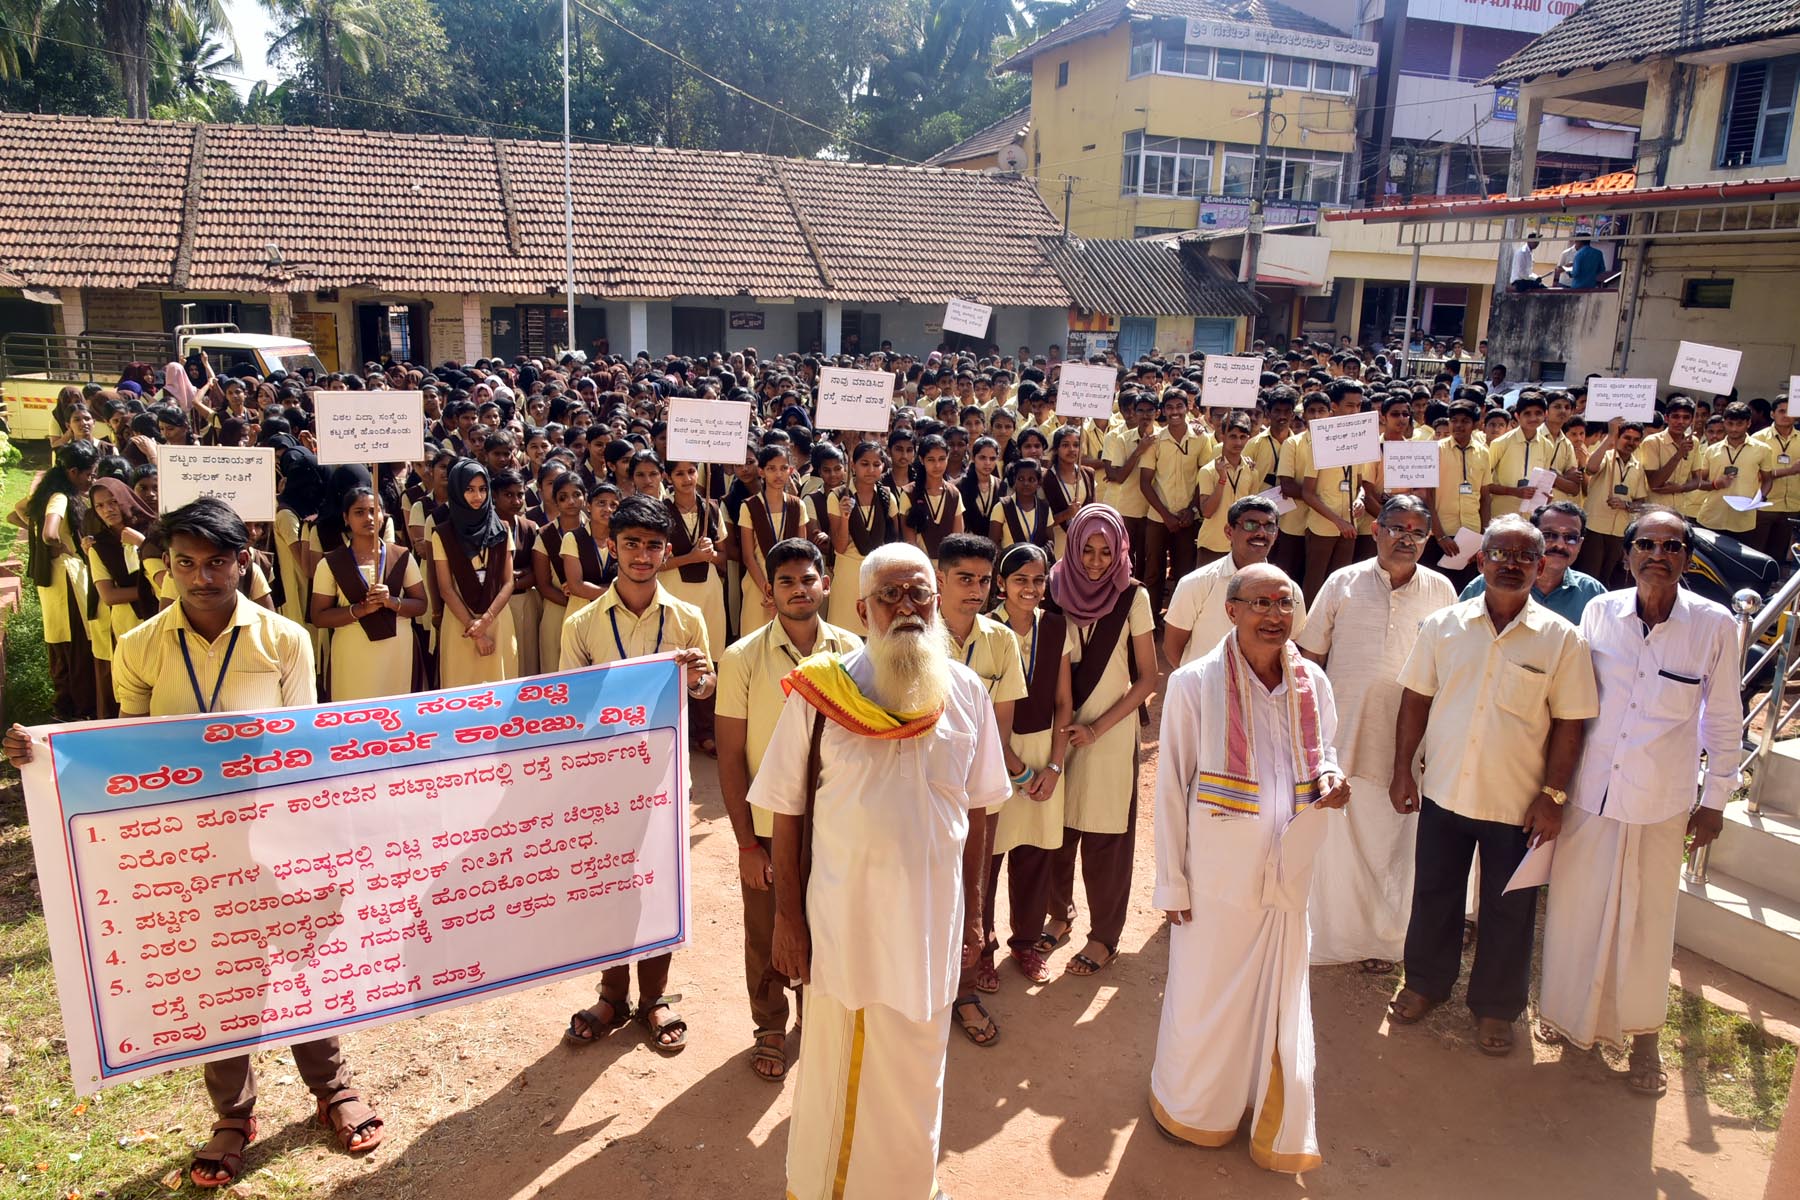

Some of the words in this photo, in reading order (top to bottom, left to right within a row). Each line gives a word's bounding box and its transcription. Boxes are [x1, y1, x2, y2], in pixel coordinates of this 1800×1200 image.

[823, 392, 837, 405] ರಸ್ತೆ
[841, 394, 862, 403] ನಮಗೆ
[865, 396, 886, 408] ಮಾತ್ರ
[831, 377, 848, 387] ನಾವು
[852, 378, 884, 387] ಮಾಡಿಸಿದ
[169, 455, 198, 467] ಪಟ್ಟಣ
[181, 473, 219, 482] ತುಘಲಕ್
[225, 473, 252, 482] ನೀತಿಗೆ
[354, 442, 368, 452] ರಸ್ತೆ
[372, 441, 389, 449] ಬೇಡ
[204, 718, 295, 743] ವಿಠಲ
[315, 707, 402, 731] ವಿದ್ಯಾ
[418, 691, 502, 714] ಸಂಘ,
[518, 683, 569, 704] ವಿಟ್ಲ
[106, 766, 203, 795] ವಿಠಲ
[222, 749, 313, 778] ಪದವಿ
[331, 731, 438, 762] ಪೂರ್ವ
[455, 714, 584, 744] ಕಾಲೇಜು,
[600, 705, 647, 726] ವಿಟ್ಲ
[87, 826, 106, 844] 1.
[119, 815, 183, 840] ಪದವಿ
[197, 801, 274, 828] ಪೂರ್ವ
[287, 784, 376, 813] ಕಾಲೇಜಿನ
[523, 756, 552, 781] ರಸ್ತೆ
[561, 740, 652, 771] ನಿರ್ಮಾಣಕ್ಕೆ
[95, 889, 118, 905] 2.
[132, 864, 260, 902] ವಿದ್ಯಾರ್ಥಿಗಳ
[273, 845, 374, 880] ಭವಿಷ್ಯದಲ್ಲಿ
[385, 839, 422, 861] ವಿಟ್ಲ
[563, 800, 619, 824] ಚೆಲ್ಲಾಟ
[630, 790, 672, 811] ಬೇಡ.
[118, 842, 217, 871] ವಿರೋಧ.
[100, 919, 122, 936] 3.
[136, 908, 200, 933] ಪಟ್ಟಣ
[367, 860, 449, 891] ತುಘಲಕ್
[461, 847, 513, 873] ನೀತಿಗೆ
[523, 831, 598, 859] ವಿರೋಧ.
[105, 950, 127, 966] 4.
[140, 937, 197, 960] ವಿಠಲ
[210, 911, 345, 949] ವಿದ್ಯಾಸಂಸ್ಥೆಯ
[357, 894, 423, 925] ಕಟ್ಟಡಕ್ಕೆ
[432, 864, 560, 906] ಹೊಂದಿಕೊಂಡು
[570, 848, 640, 880] ರಸ್ತೆಬೇಡ.
[110, 979, 131, 996] 5.
[145, 967, 201, 989] ವಿಠಲ
[215, 938, 348, 976] ವಿದ್ಯಾಸಂಸ್ಥೆಯ
[360, 919, 432, 948] ಗಮನಕ್ಕೆ
[441, 905, 496, 930] ತಾರದೆ
[567, 869, 655, 902] ಸಾರ್ವಜನಿಕ
[118, 1037, 140, 1054] 6.
[153, 1022, 207, 1046] ನಾವು
[219, 999, 312, 1032] ಮಾಡಿಸಿದ
[324, 990, 357, 1014] ರಸ್ತೆ
[366, 975, 421, 1002] ನಮಗೆ
[152, 996, 188, 1021] ರಸ್ತೆ
[198, 973, 311, 1009] ನಿರ್ಮಾಣಕ್ಕೆ
[321, 953, 406, 984] ವಿರೋಧ.
